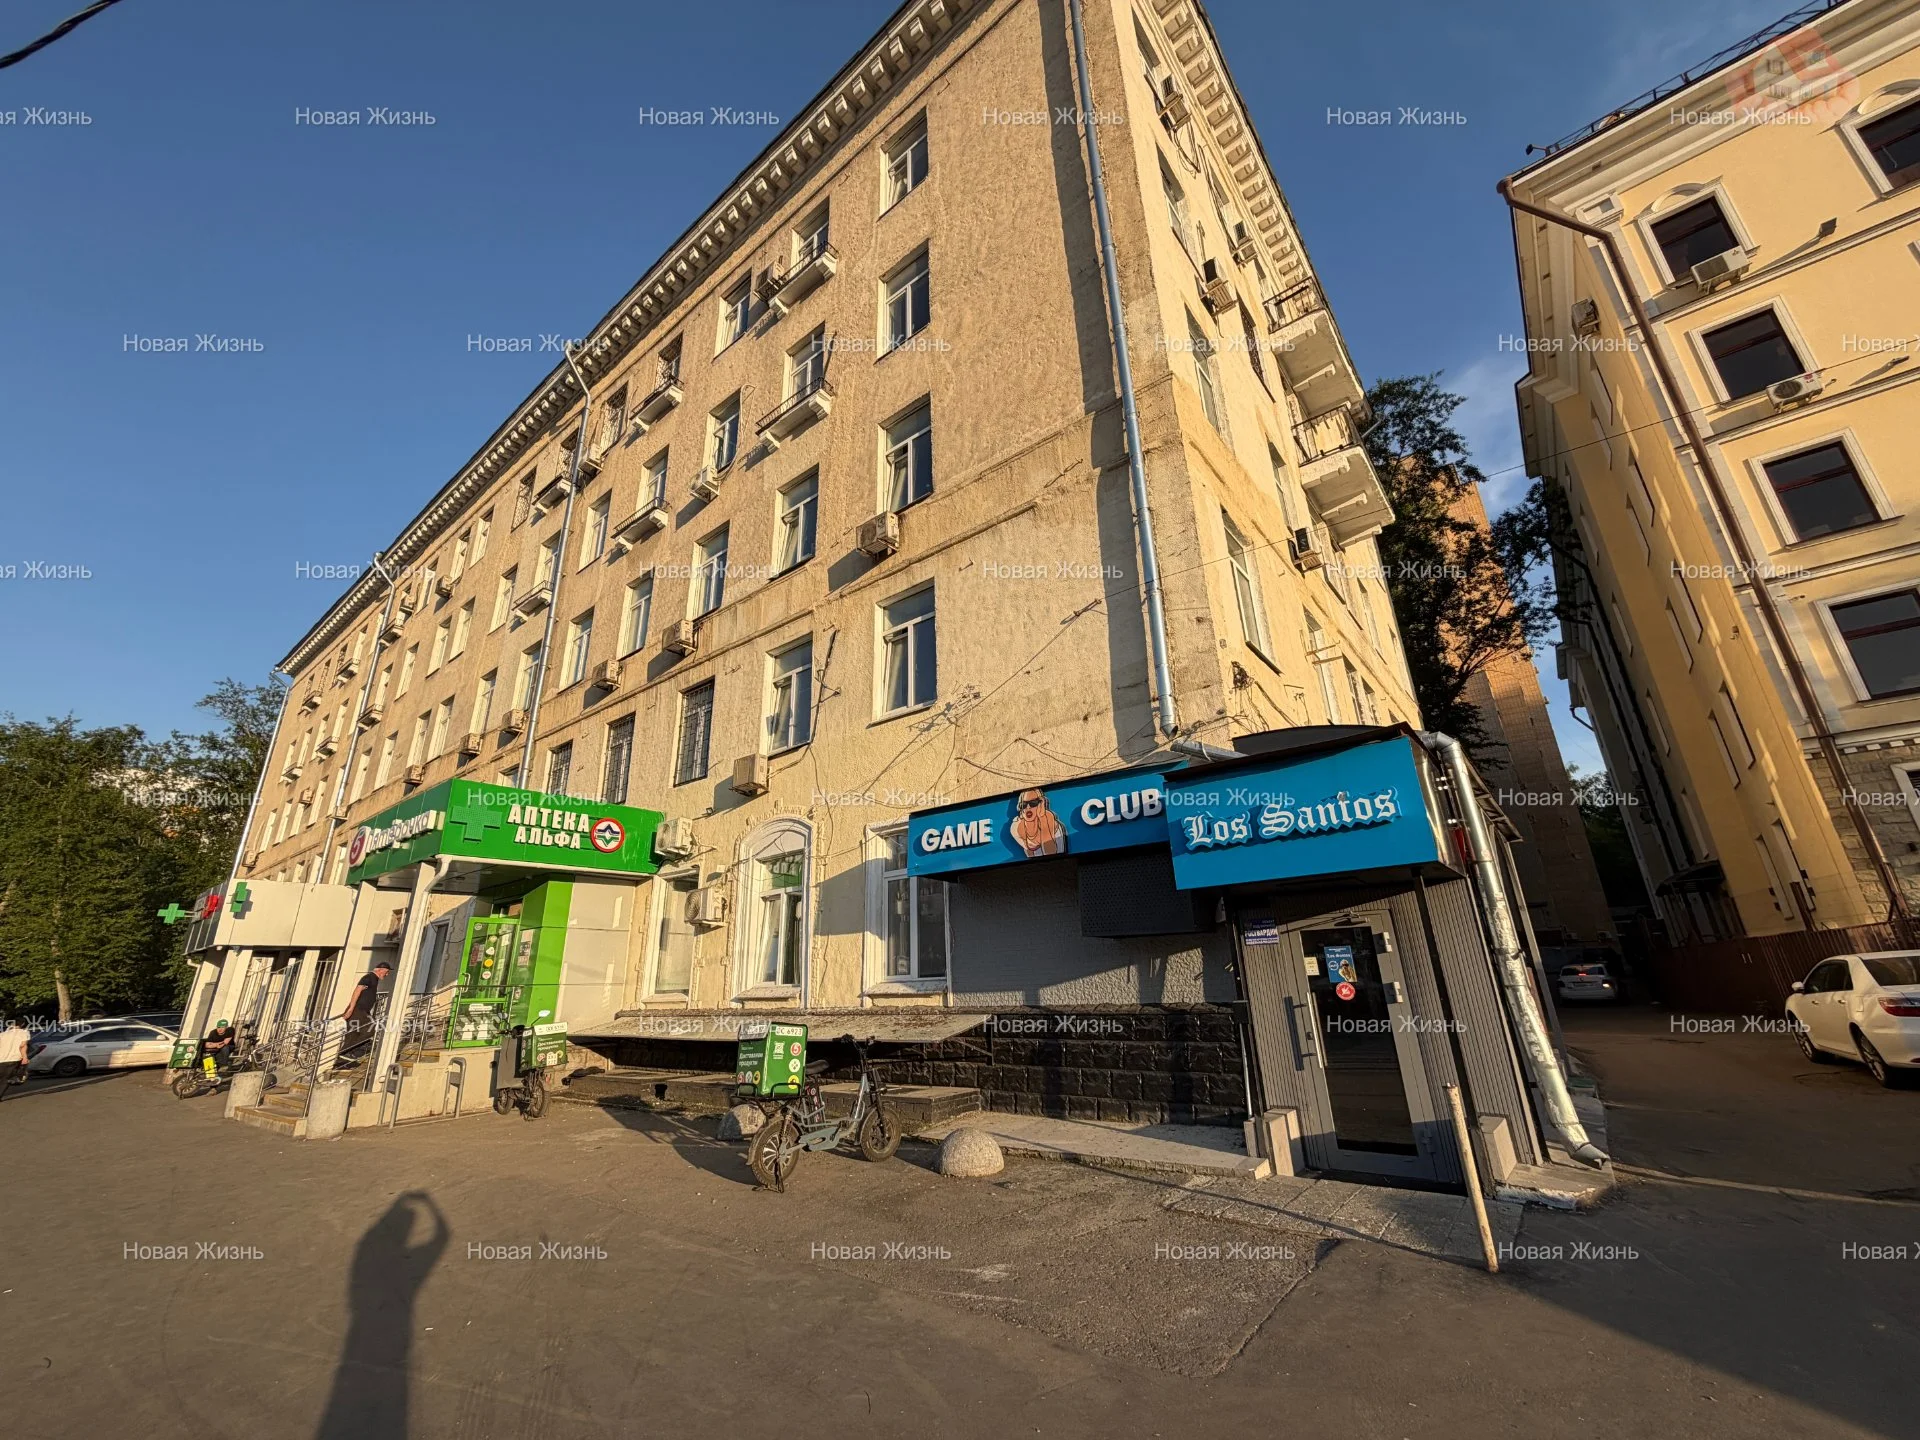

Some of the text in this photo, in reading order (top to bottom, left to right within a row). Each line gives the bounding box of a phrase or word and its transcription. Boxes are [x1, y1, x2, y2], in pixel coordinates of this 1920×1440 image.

[507, 803, 590, 833] АПТЕКА
[514, 826, 581, 850] АЛЬФА
[921, 787, 1162, 852] GAME CLUB
[1182, 788, 1399, 851] Los Santos
